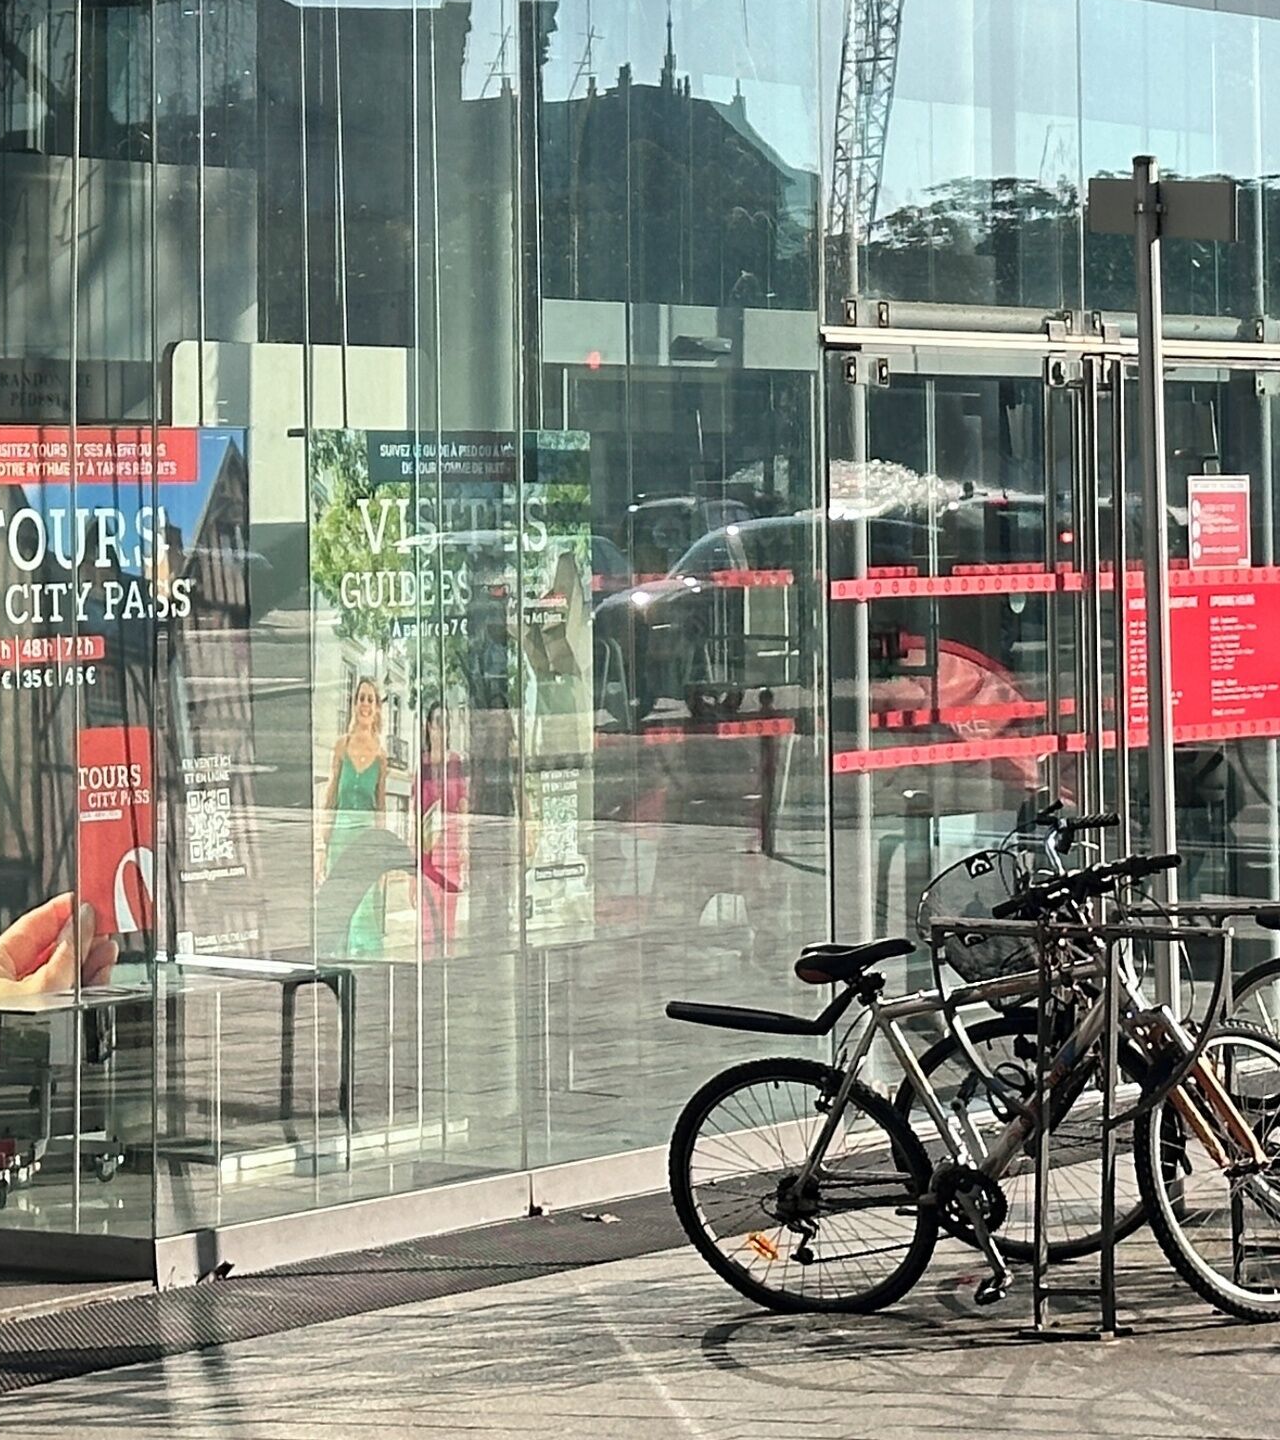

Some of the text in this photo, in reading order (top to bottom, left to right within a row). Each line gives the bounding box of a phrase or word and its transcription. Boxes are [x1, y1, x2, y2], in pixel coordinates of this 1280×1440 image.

[32, 443, 67, 458] TOURS
[83, 443, 104, 457] SES
[27, 462, 70, 476] RYTHME
[86, 458, 95, 475] À
[132, 460, 177, 476] RÉDITS
[357, 496, 548, 555] VISITES
[340, 559, 473, 610] GUIDÉES
[4, 576, 197, 625] CITY PASS
[78, 764, 142, 791] TOURS
[87, 789, 151, 808] CITY PASS
